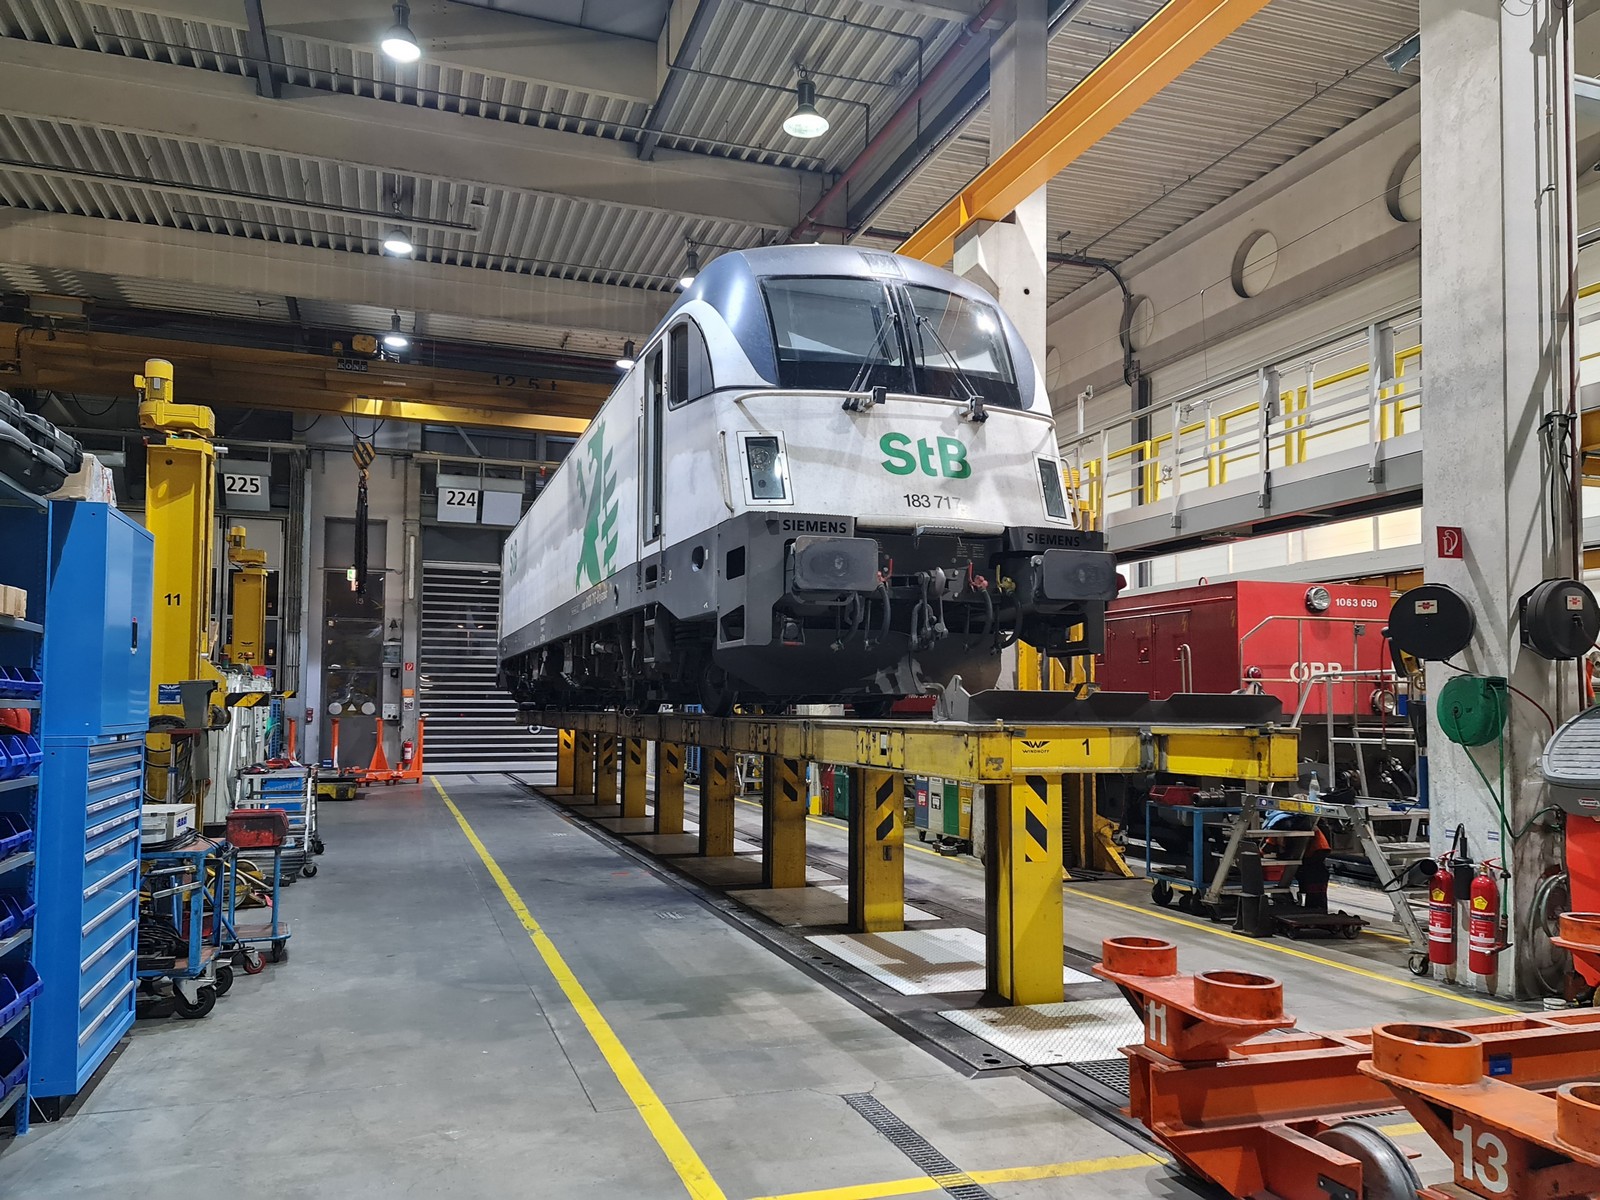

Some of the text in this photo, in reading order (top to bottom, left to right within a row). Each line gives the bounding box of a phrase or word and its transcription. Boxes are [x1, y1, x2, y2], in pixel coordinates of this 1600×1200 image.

[879, 432, 972, 479] StB
[226, 476, 260, 493] 225
[446, 490, 477, 507] 224
[903, 493, 931, 508] 183
[782, 519, 847, 534] SIEMENS
[1027, 533, 1080, 547] SIEMENS
[164, 593, 181, 606] 11
[1335, 598, 1378, 608] 1063 050
[1082, 738, 1091, 756] 1
[1144, 1000, 1167, 1047] 11
[1453, 1123, 1509, 1194] 13
